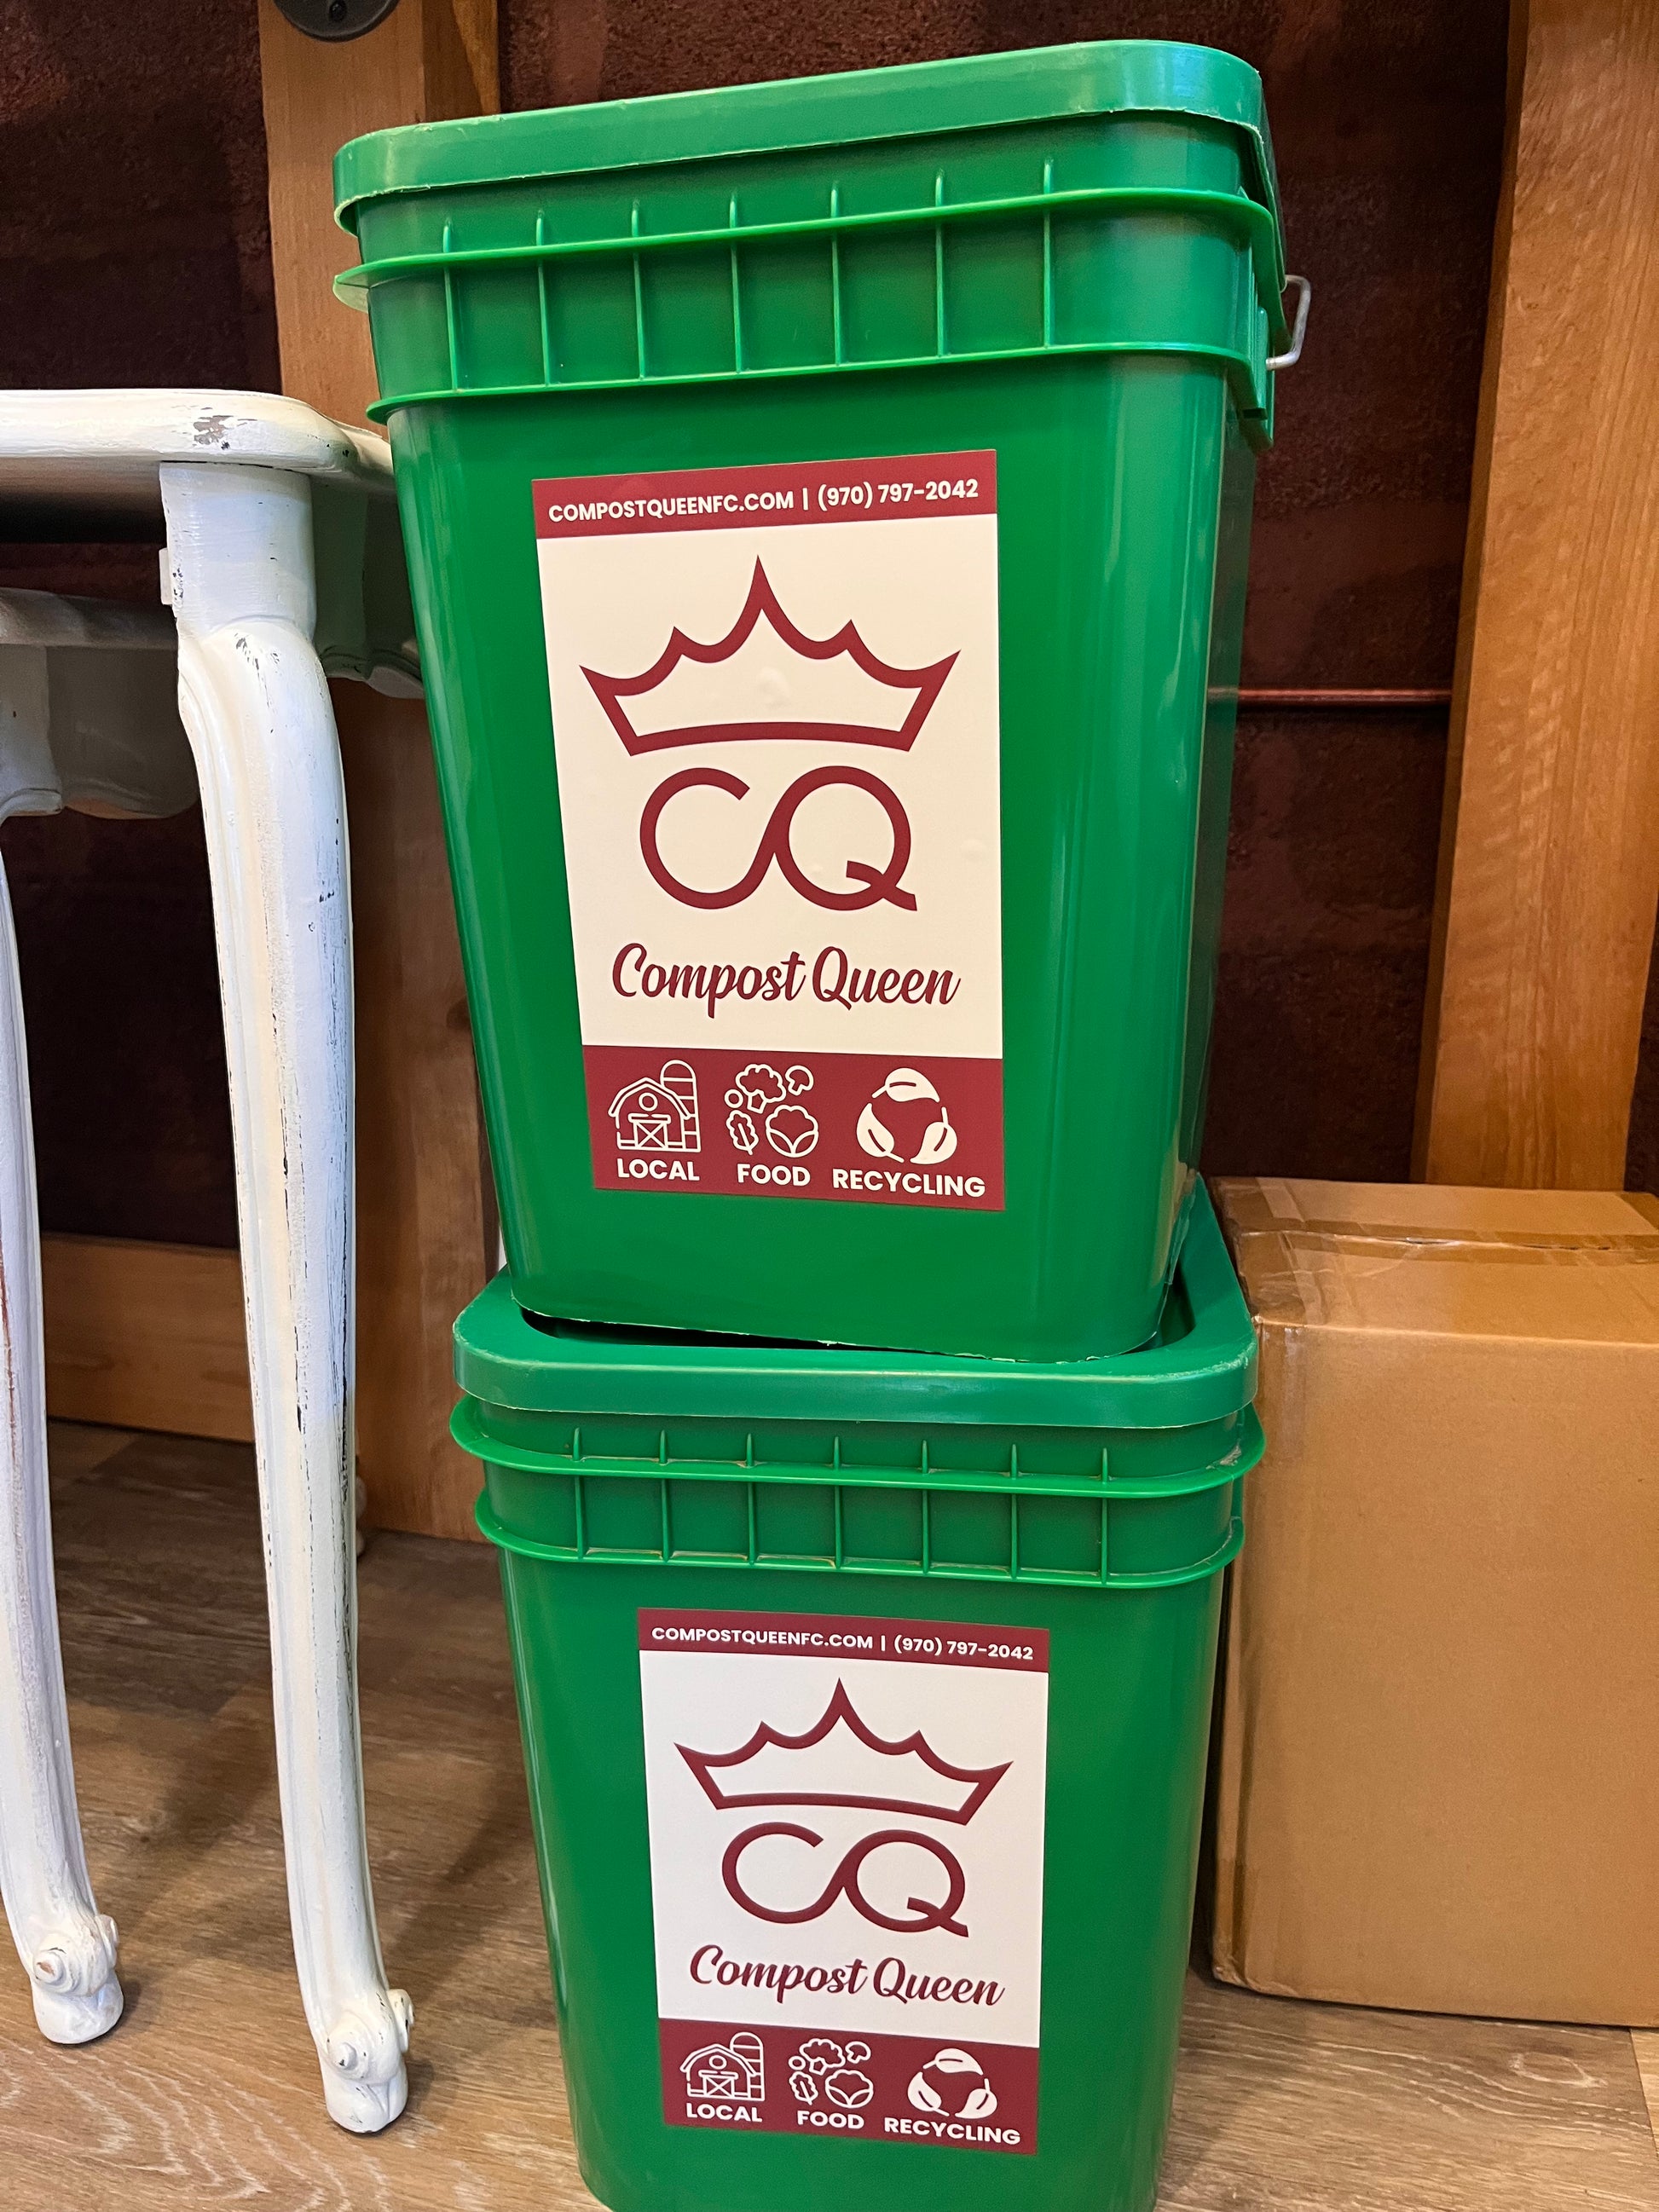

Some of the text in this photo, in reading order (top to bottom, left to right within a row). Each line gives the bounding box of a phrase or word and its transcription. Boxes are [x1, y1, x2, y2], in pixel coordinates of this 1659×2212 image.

[548, 491, 795, 523] COMPOSTQUEENFC.COM
[818, 482, 874, 512] (970)
[878, 478, 979, 504] 797-2042
[639, 765, 917, 911] CQ
[612, 943, 961, 1019] Compost Queen
[616, 1158, 986, 1197] LOCAL FOOD RECYCLING
[651, 1626, 873, 1649] COMPOSTQUEENFC.COM
[893, 1637, 943, 1655] (970)
[946, 1640, 1034, 1660] 797-2042
[721, 1822, 969, 1938] CQ
[689, 1944, 1006, 2007] Compost Queen
[685, 2102, 1021, 2146] LOCAL FOOD RECYCLING
